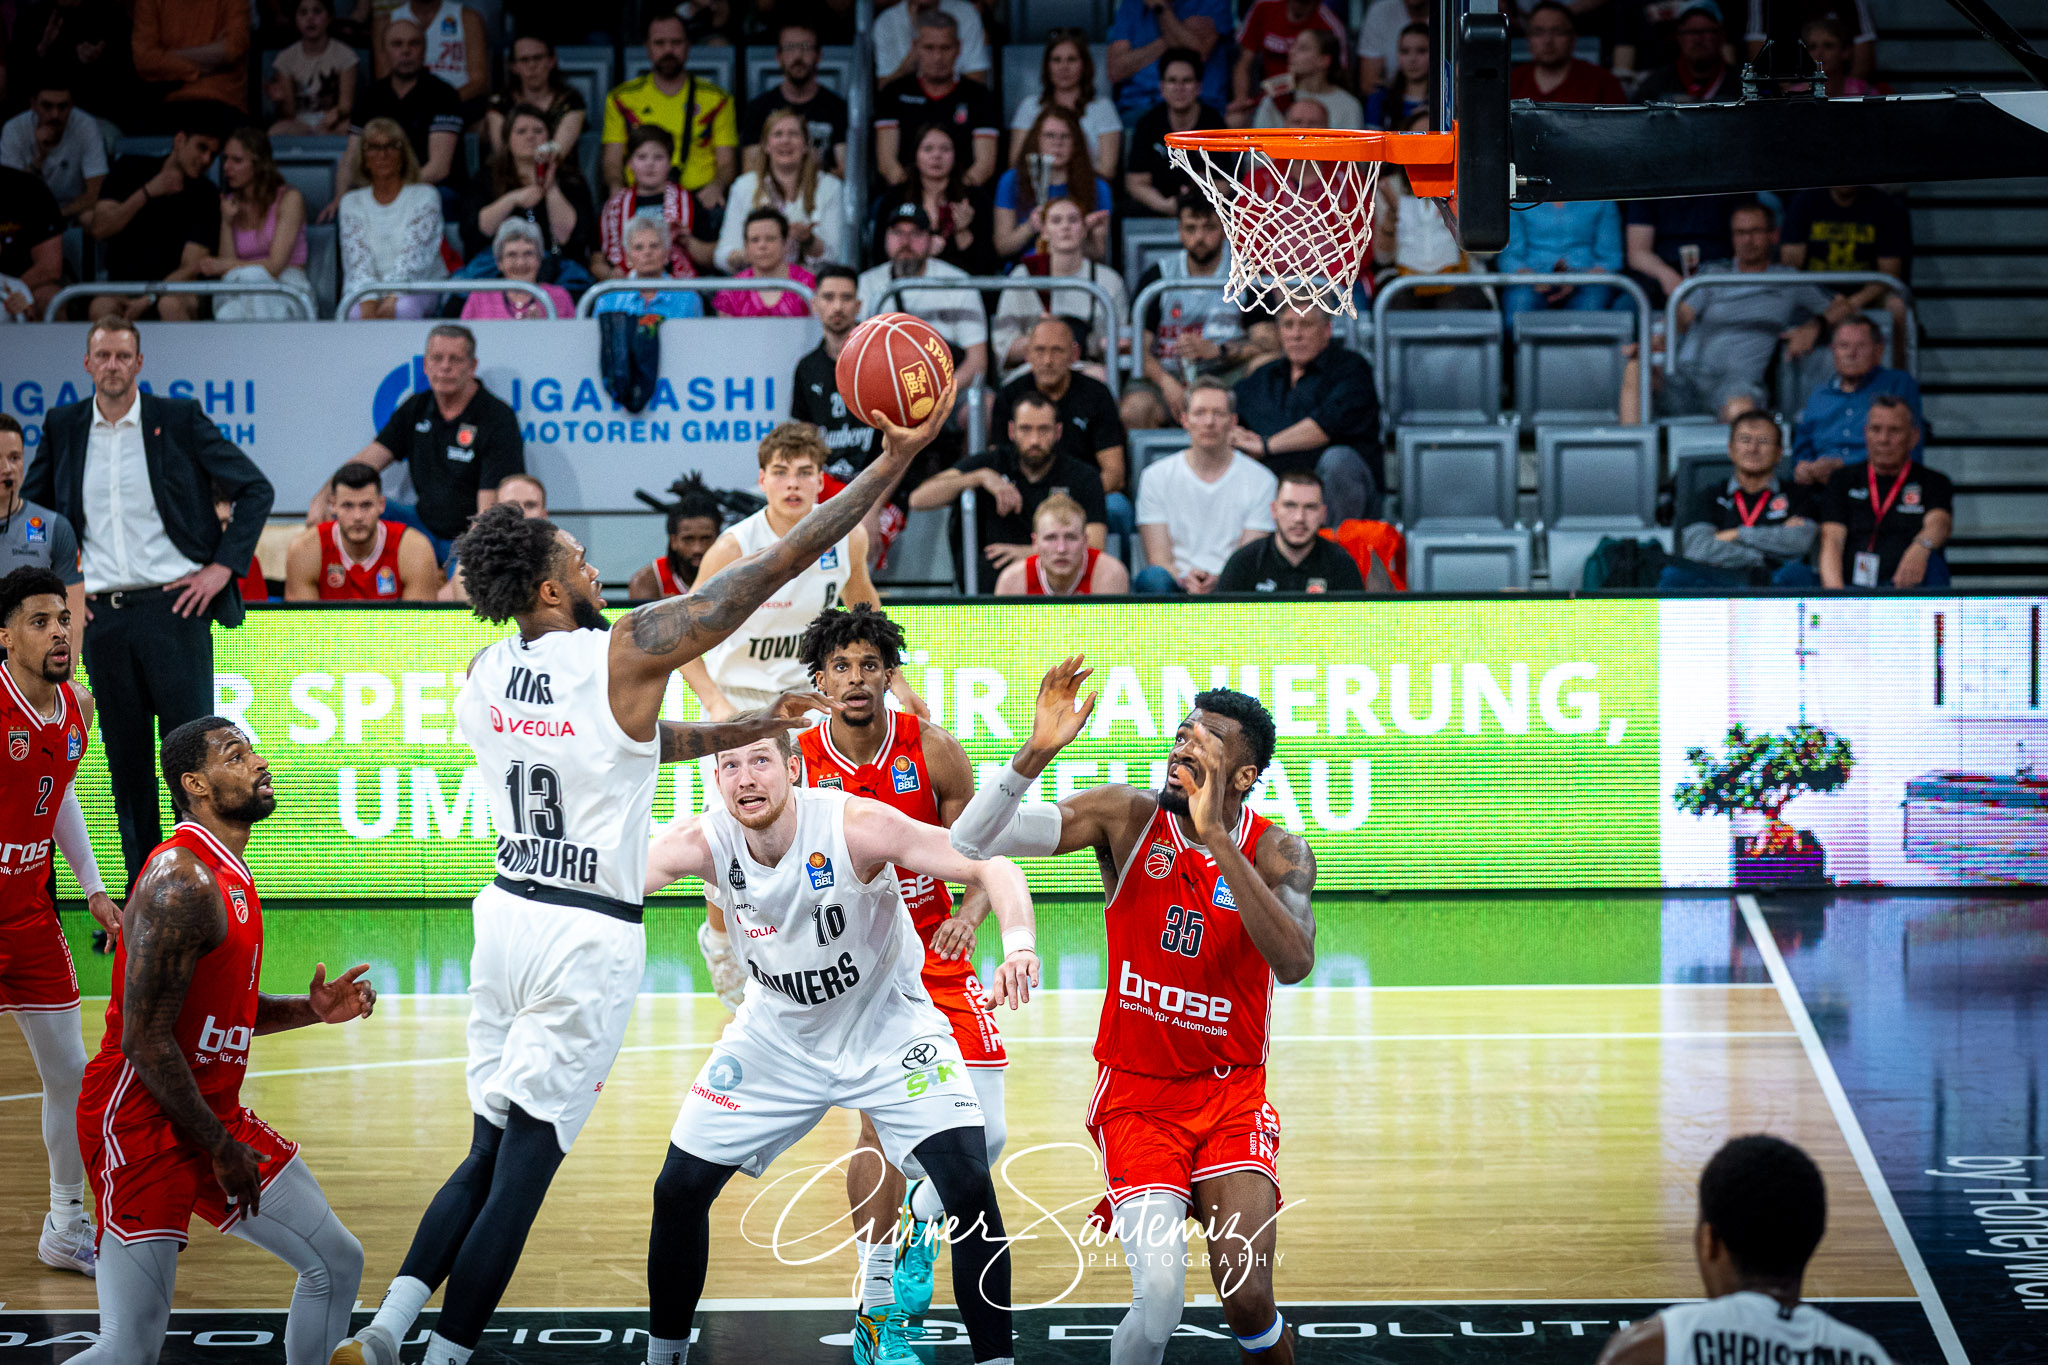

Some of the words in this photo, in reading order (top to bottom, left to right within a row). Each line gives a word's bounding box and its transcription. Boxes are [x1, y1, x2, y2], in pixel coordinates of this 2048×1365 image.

[924, 337, 955, 385] SPALD
[0, 380, 254, 416] GASHI
[511, 376, 774, 413] IGAASHI
[904, 371, 916, 398] BBL
[682, 420, 774, 443] GMBH
[819, 425, 874, 451] amberg
[749, 634, 803, 661] TOW
[508, 717, 576, 737] VEOLIA
[34, 776, 54, 816] 2
[505, 760, 567, 842] 13
[897, 780, 917, 791] BBL
[814, 877, 834, 888] BBL
[1215, 894, 1237, 908] BBL
[744, 925, 778, 939] EOLIA
[812, 904, 847, 947] 10
[1160, 904, 1205, 959] 35
[1119, 960, 1232, 1023] brose
[1119, 998, 1155, 1018] Technik
[1154, 1011, 1170, 1023] für
[1171, 1016, 1228, 1037] Automobile
[978, 1020, 991, 1054] KOLLEGEN
[906, 1060, 957, 1098] S+K
[691, 1082, 741, 1112] Schindler
